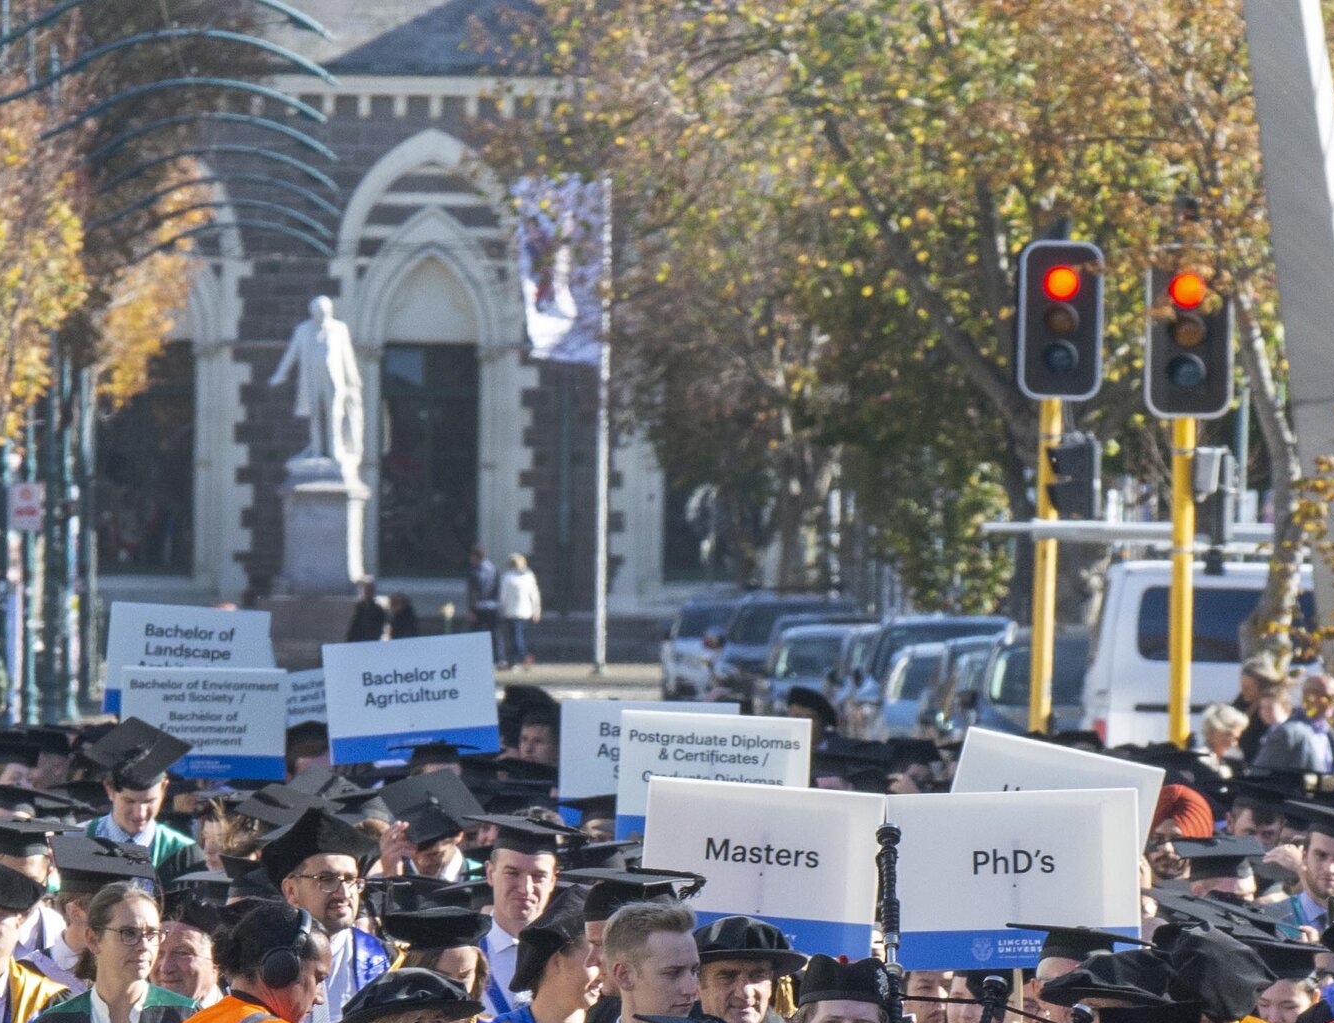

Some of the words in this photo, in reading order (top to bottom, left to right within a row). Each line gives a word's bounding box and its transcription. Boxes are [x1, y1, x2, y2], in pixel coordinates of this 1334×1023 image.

[145, 624, 214, 641] Bachelor
[219, 628, 235, 642] of
[145, 642, 232, 661] Landscape
[362, 668, 435, 687] Bachelor
[440, 664, 457, 680] of
[130, 679, 183, 690] Bachelor
[186, 680, 199, 690] of
[202, 680, 279, 691] Environment
[163, 693, 185, 702] and
[188, 692, 234, 704] Society
[365, 688, 459, 709] Agriculture
[169, 711, 222, 721] Bachelor
[226, 711, 238, 721] of
[190, 737, 242, 748] agement
[629, 729, 728, 747] Postgraduate
[732, 735, 801, 755] Diplomas
[658, 750, 668, 761] &
[673, 749, 759, 765] Certificates
[705, 837, 820, 869] Masters
